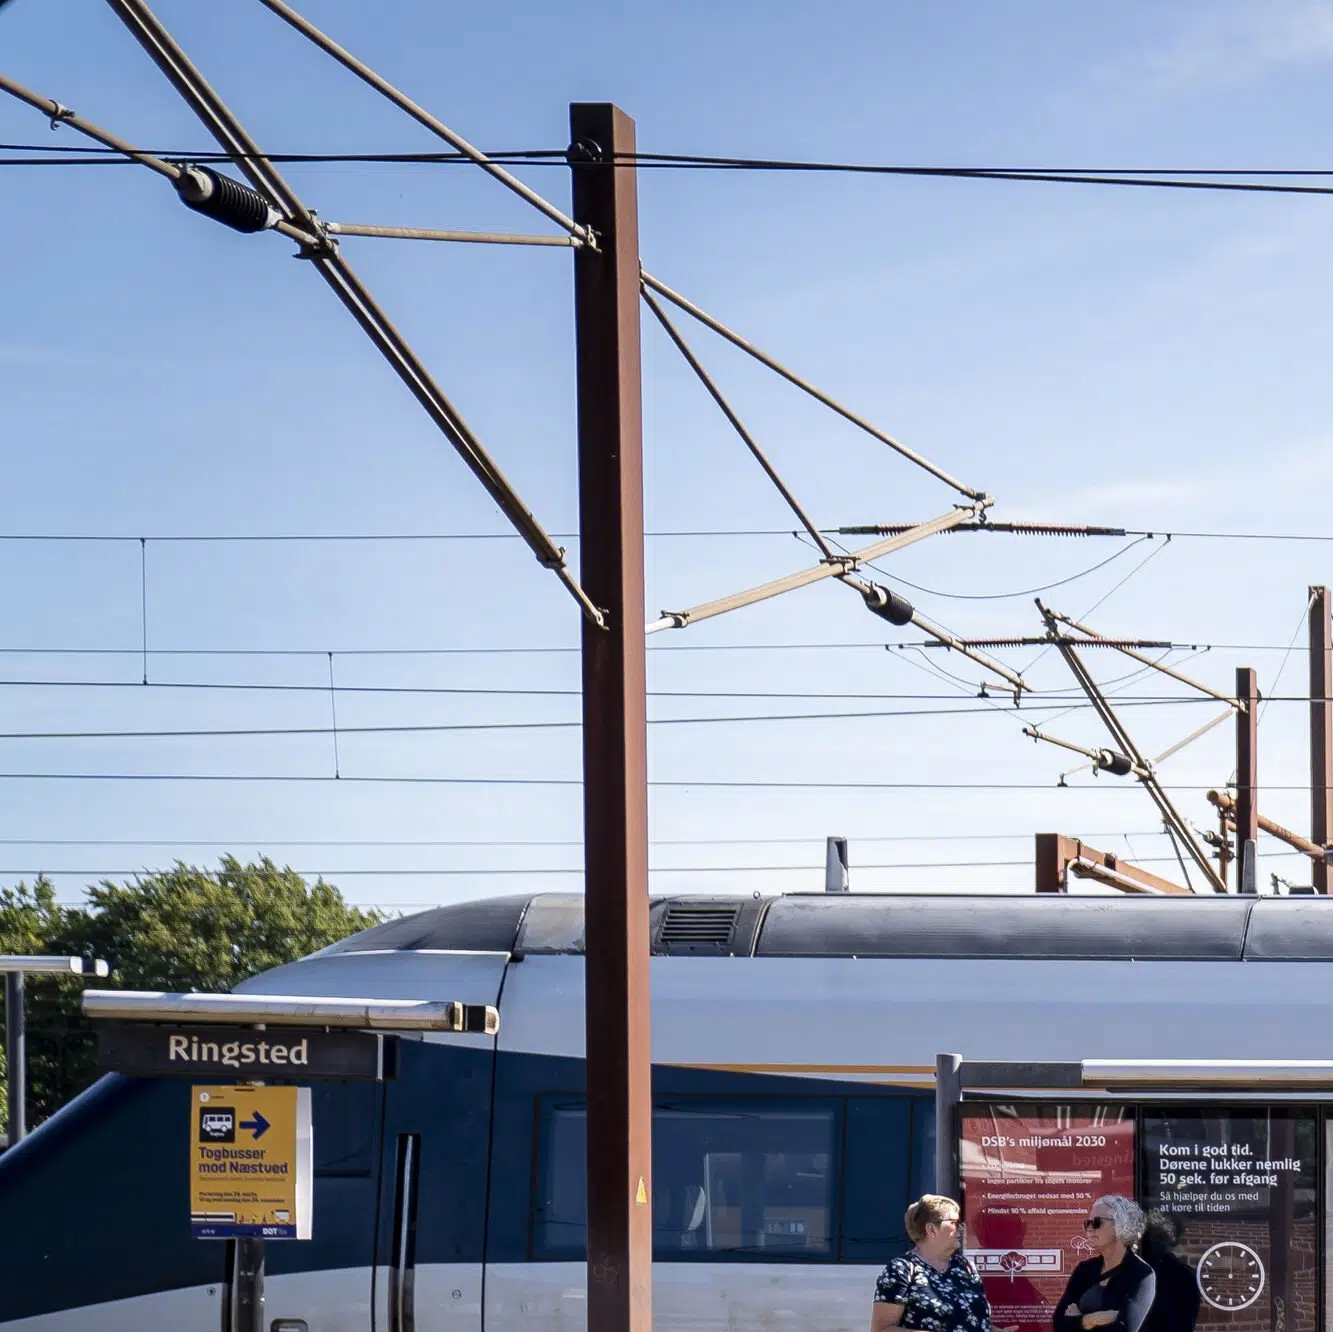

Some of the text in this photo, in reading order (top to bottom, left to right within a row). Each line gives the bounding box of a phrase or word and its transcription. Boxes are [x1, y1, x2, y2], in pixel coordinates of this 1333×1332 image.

[169, 1035, 308, 1068] Ringsted
[981, 1135, 1106, 1149] DSB's miljømål 2030
[199, 1147, 265, 1161] Togbusser
[1160, 1144, 1253, 1158] Kom i god tid.
[199, 1162, 288, 1173] mod Næstved
[1160, 1158, 1301, 1171] Dørene lukker nemlig
[1160, 1173, 1278, 1186] 50 sek. før afgang
[1160, 1191, 1171, 1201] Så
[1173, 1191, 1207, 1202] hjælper
[1210, 1192, 1222, 1201] du
[1238, 1192, 1259, 1201] med
[1160, 1204, 1169, 1212] at
[1194, 1203, 1204, 1212] til
[1206, 1203, 1231, 1212] tiden
